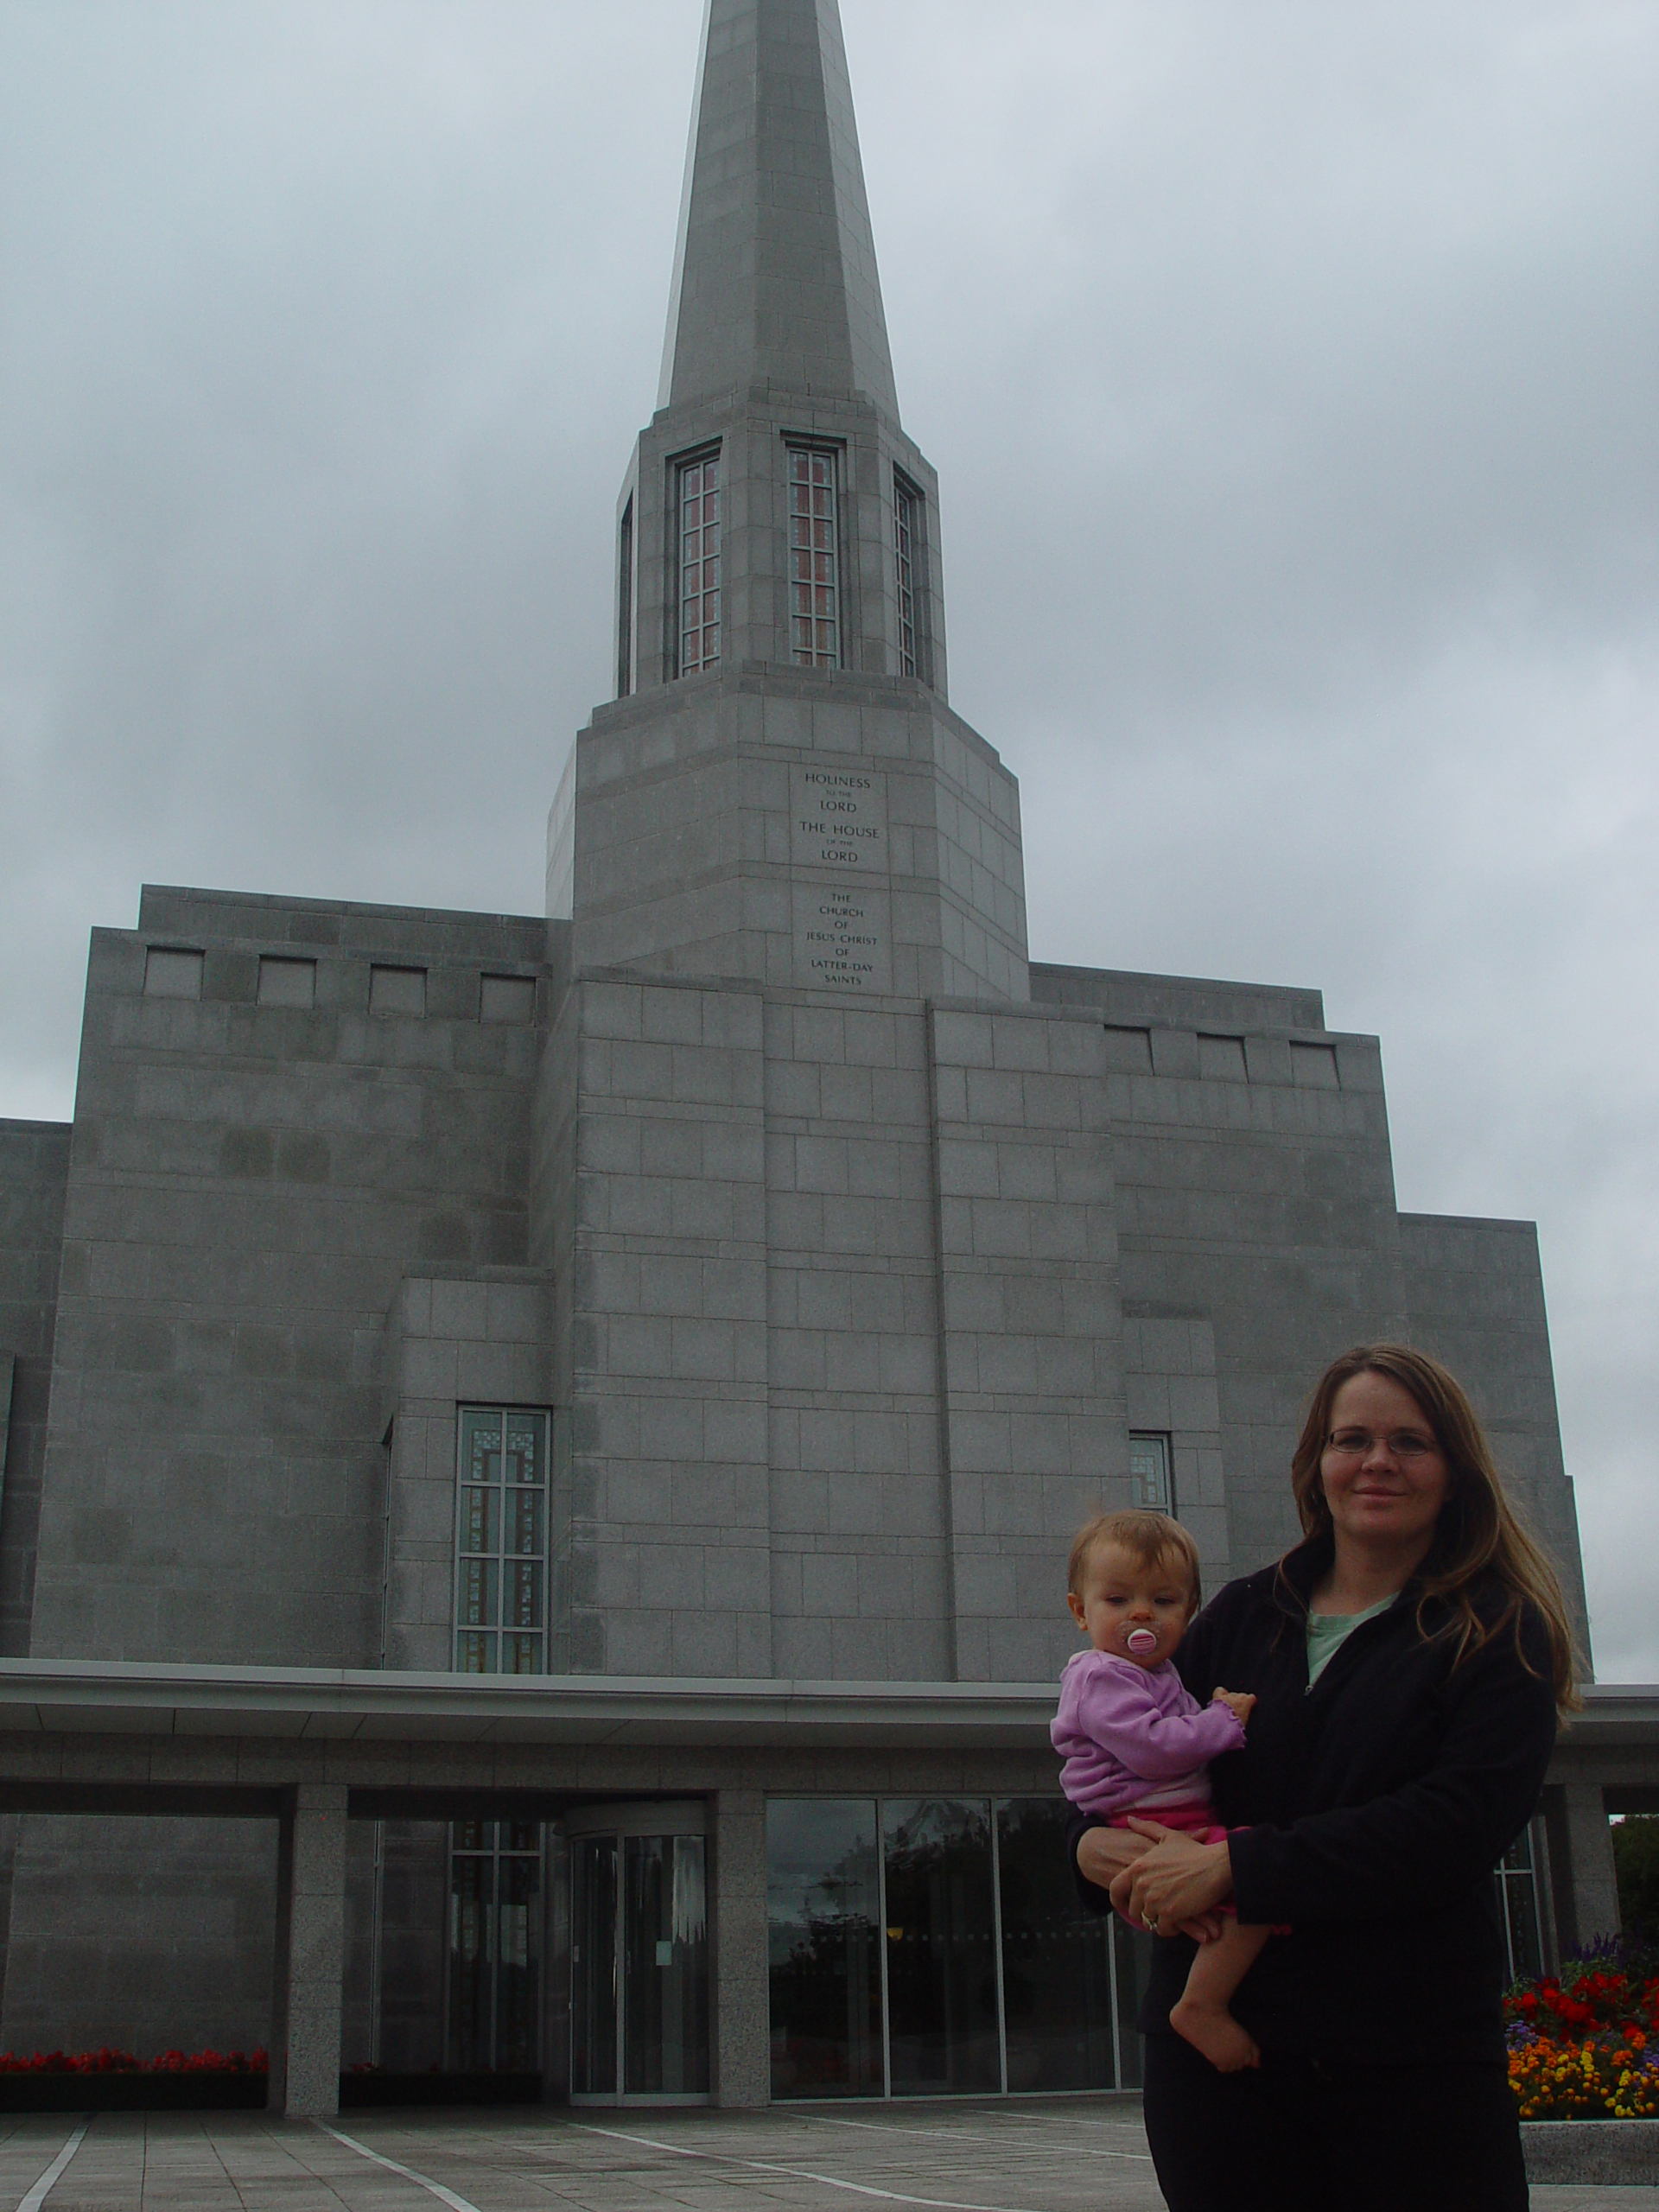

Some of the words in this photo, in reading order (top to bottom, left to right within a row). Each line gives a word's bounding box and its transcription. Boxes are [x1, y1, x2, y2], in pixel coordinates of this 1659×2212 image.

[805, 773, 870, 788] HOLINESS
[821, 800, 856, 812] LORD
[799, 822, 825, 833] THE
[834, 825, 880, 838] HOUSE
[822, 850, 858, 862] LORD
[832, 893, 850, 903] THE
[820, 906, 864, 917] CHURCH
[807, 932, 835, 941] JESUS
[840, 935, 877, 945] CHRIST
[811, 960, 874, 972] LATTER-DAY
[825, 975, 861, 985] SAINTS
